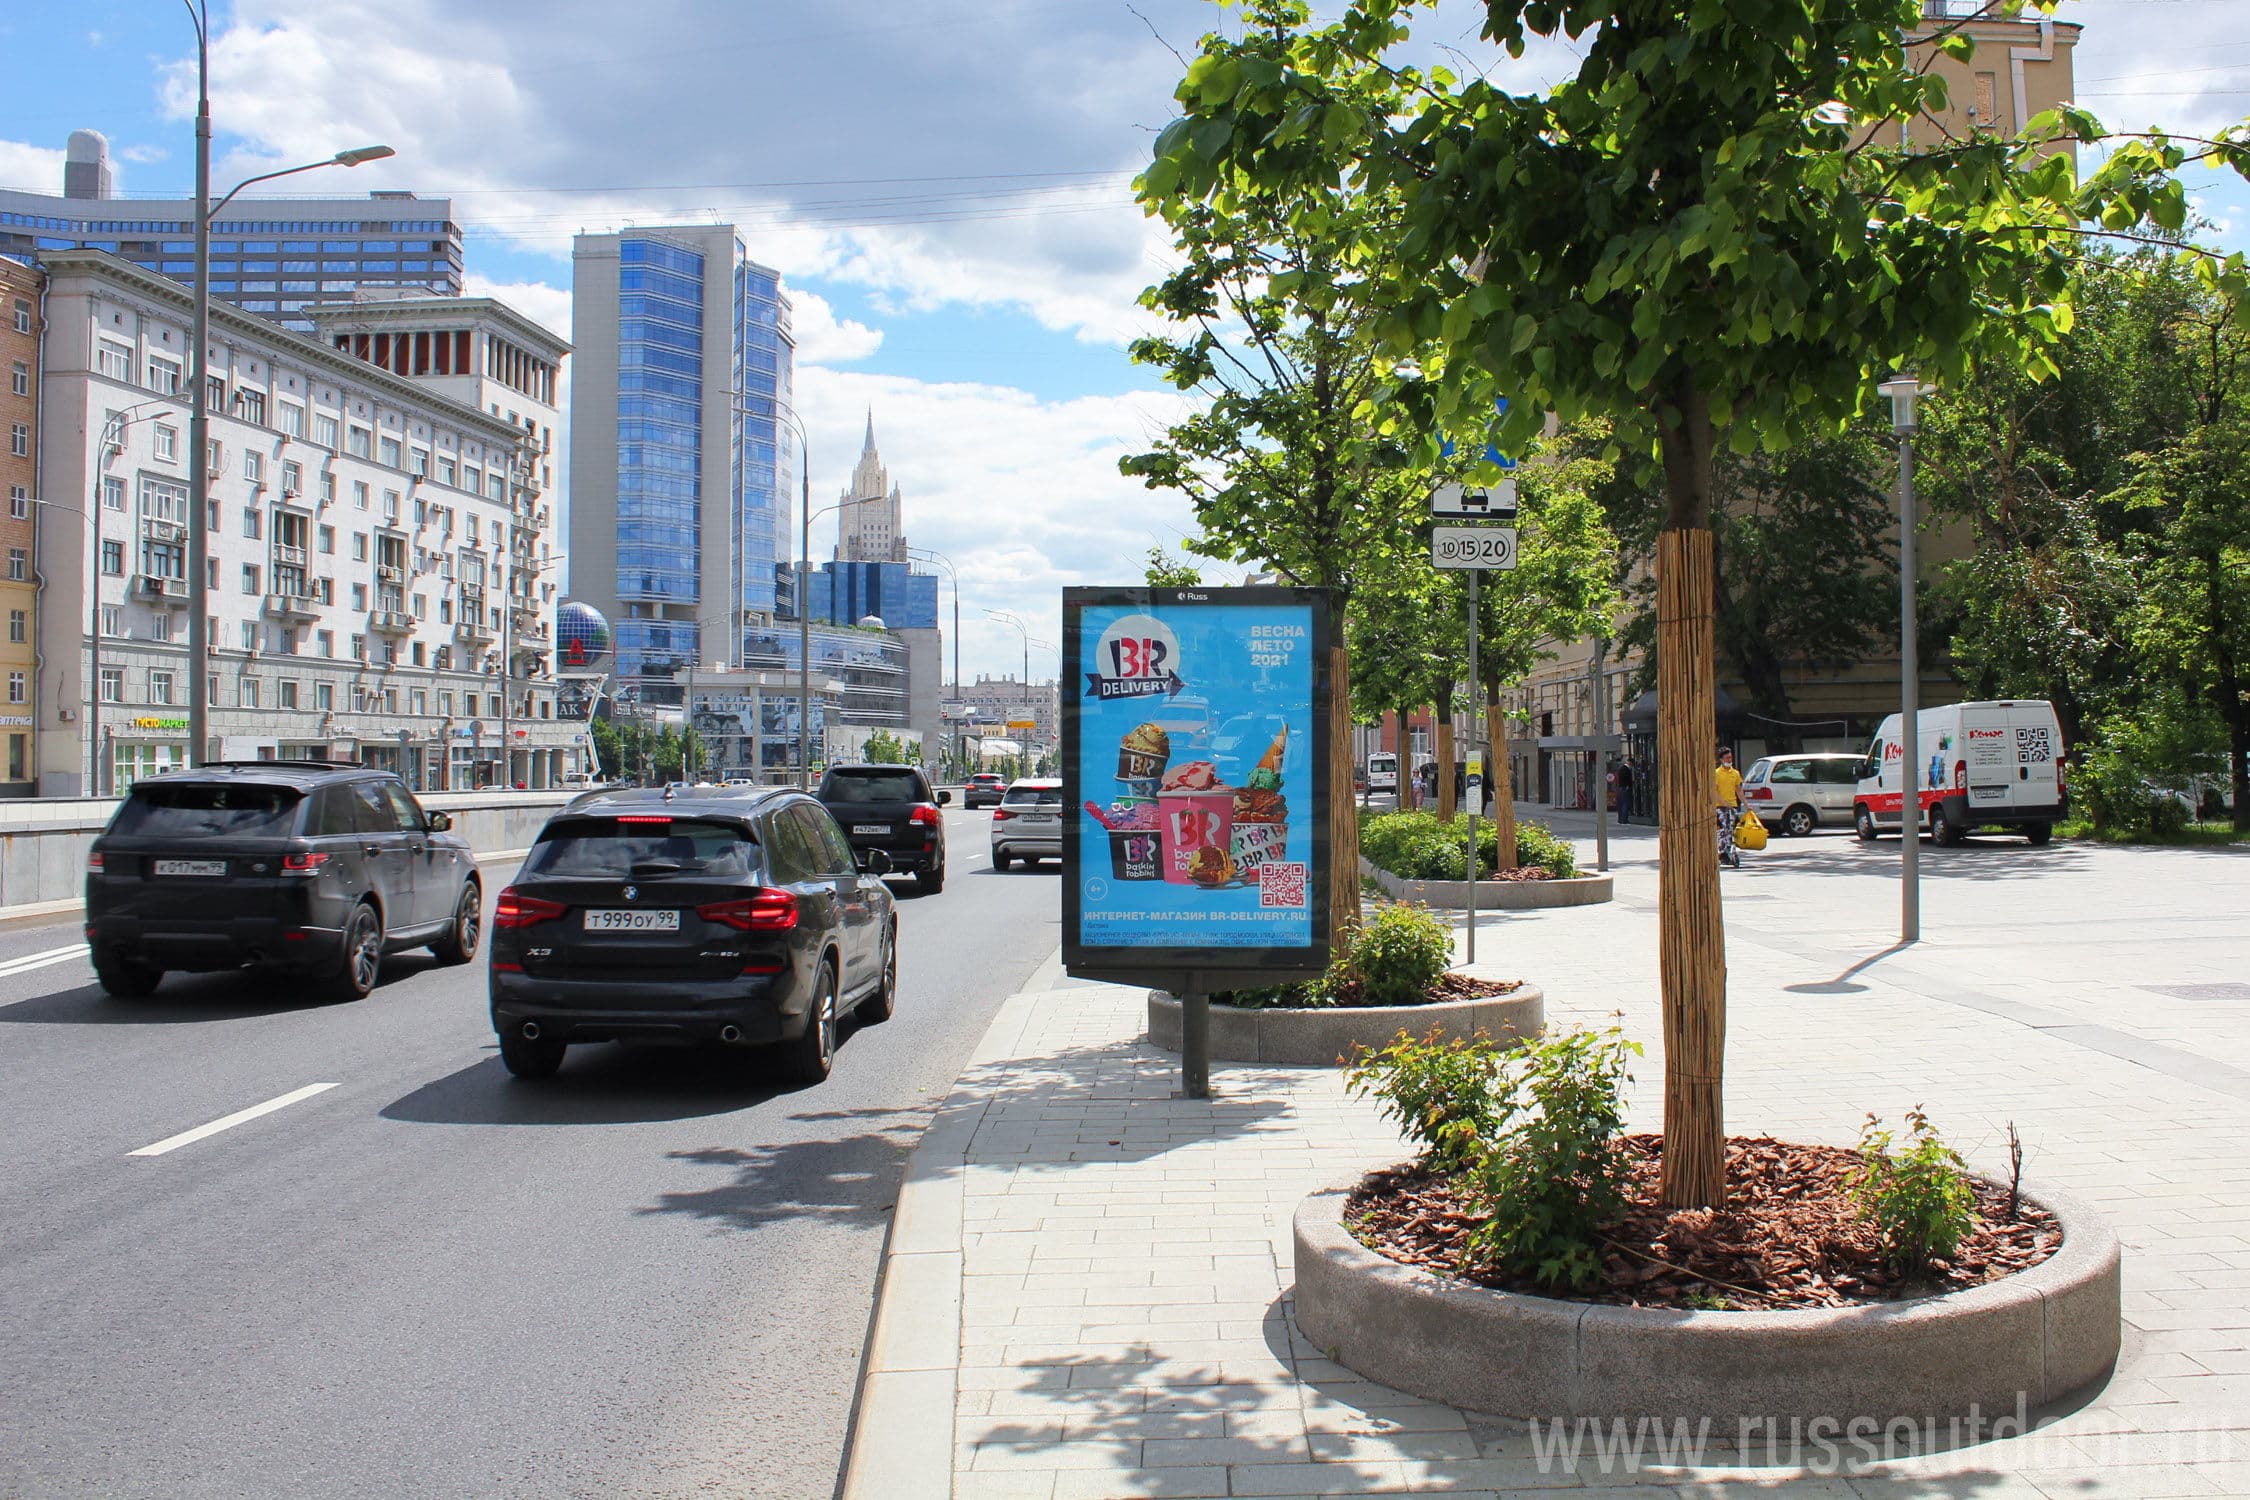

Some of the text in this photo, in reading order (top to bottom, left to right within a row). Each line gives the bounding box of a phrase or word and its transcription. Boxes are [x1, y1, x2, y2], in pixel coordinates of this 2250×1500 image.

[1441, 540, 1506, 558] 10 15 20
[1187, 592, 1208, 601] Russ
[1251, 625, 1306, 638] ВЕСНА
[1250, 640, 1295, 652] ЛЕТО
[1109, 637, 1168, 679] BR
[1251, 654, 1289, 666] 2021
[1102, 679, 1170, 697] DELIVERY
[1170, 808, 1221, 846] BR
[1084, 911, 1307, 921] ИНТЕРНЕТ-МАГАЗИН BR-DELIVERY.RU
[527, 948, 552, 957] X3
